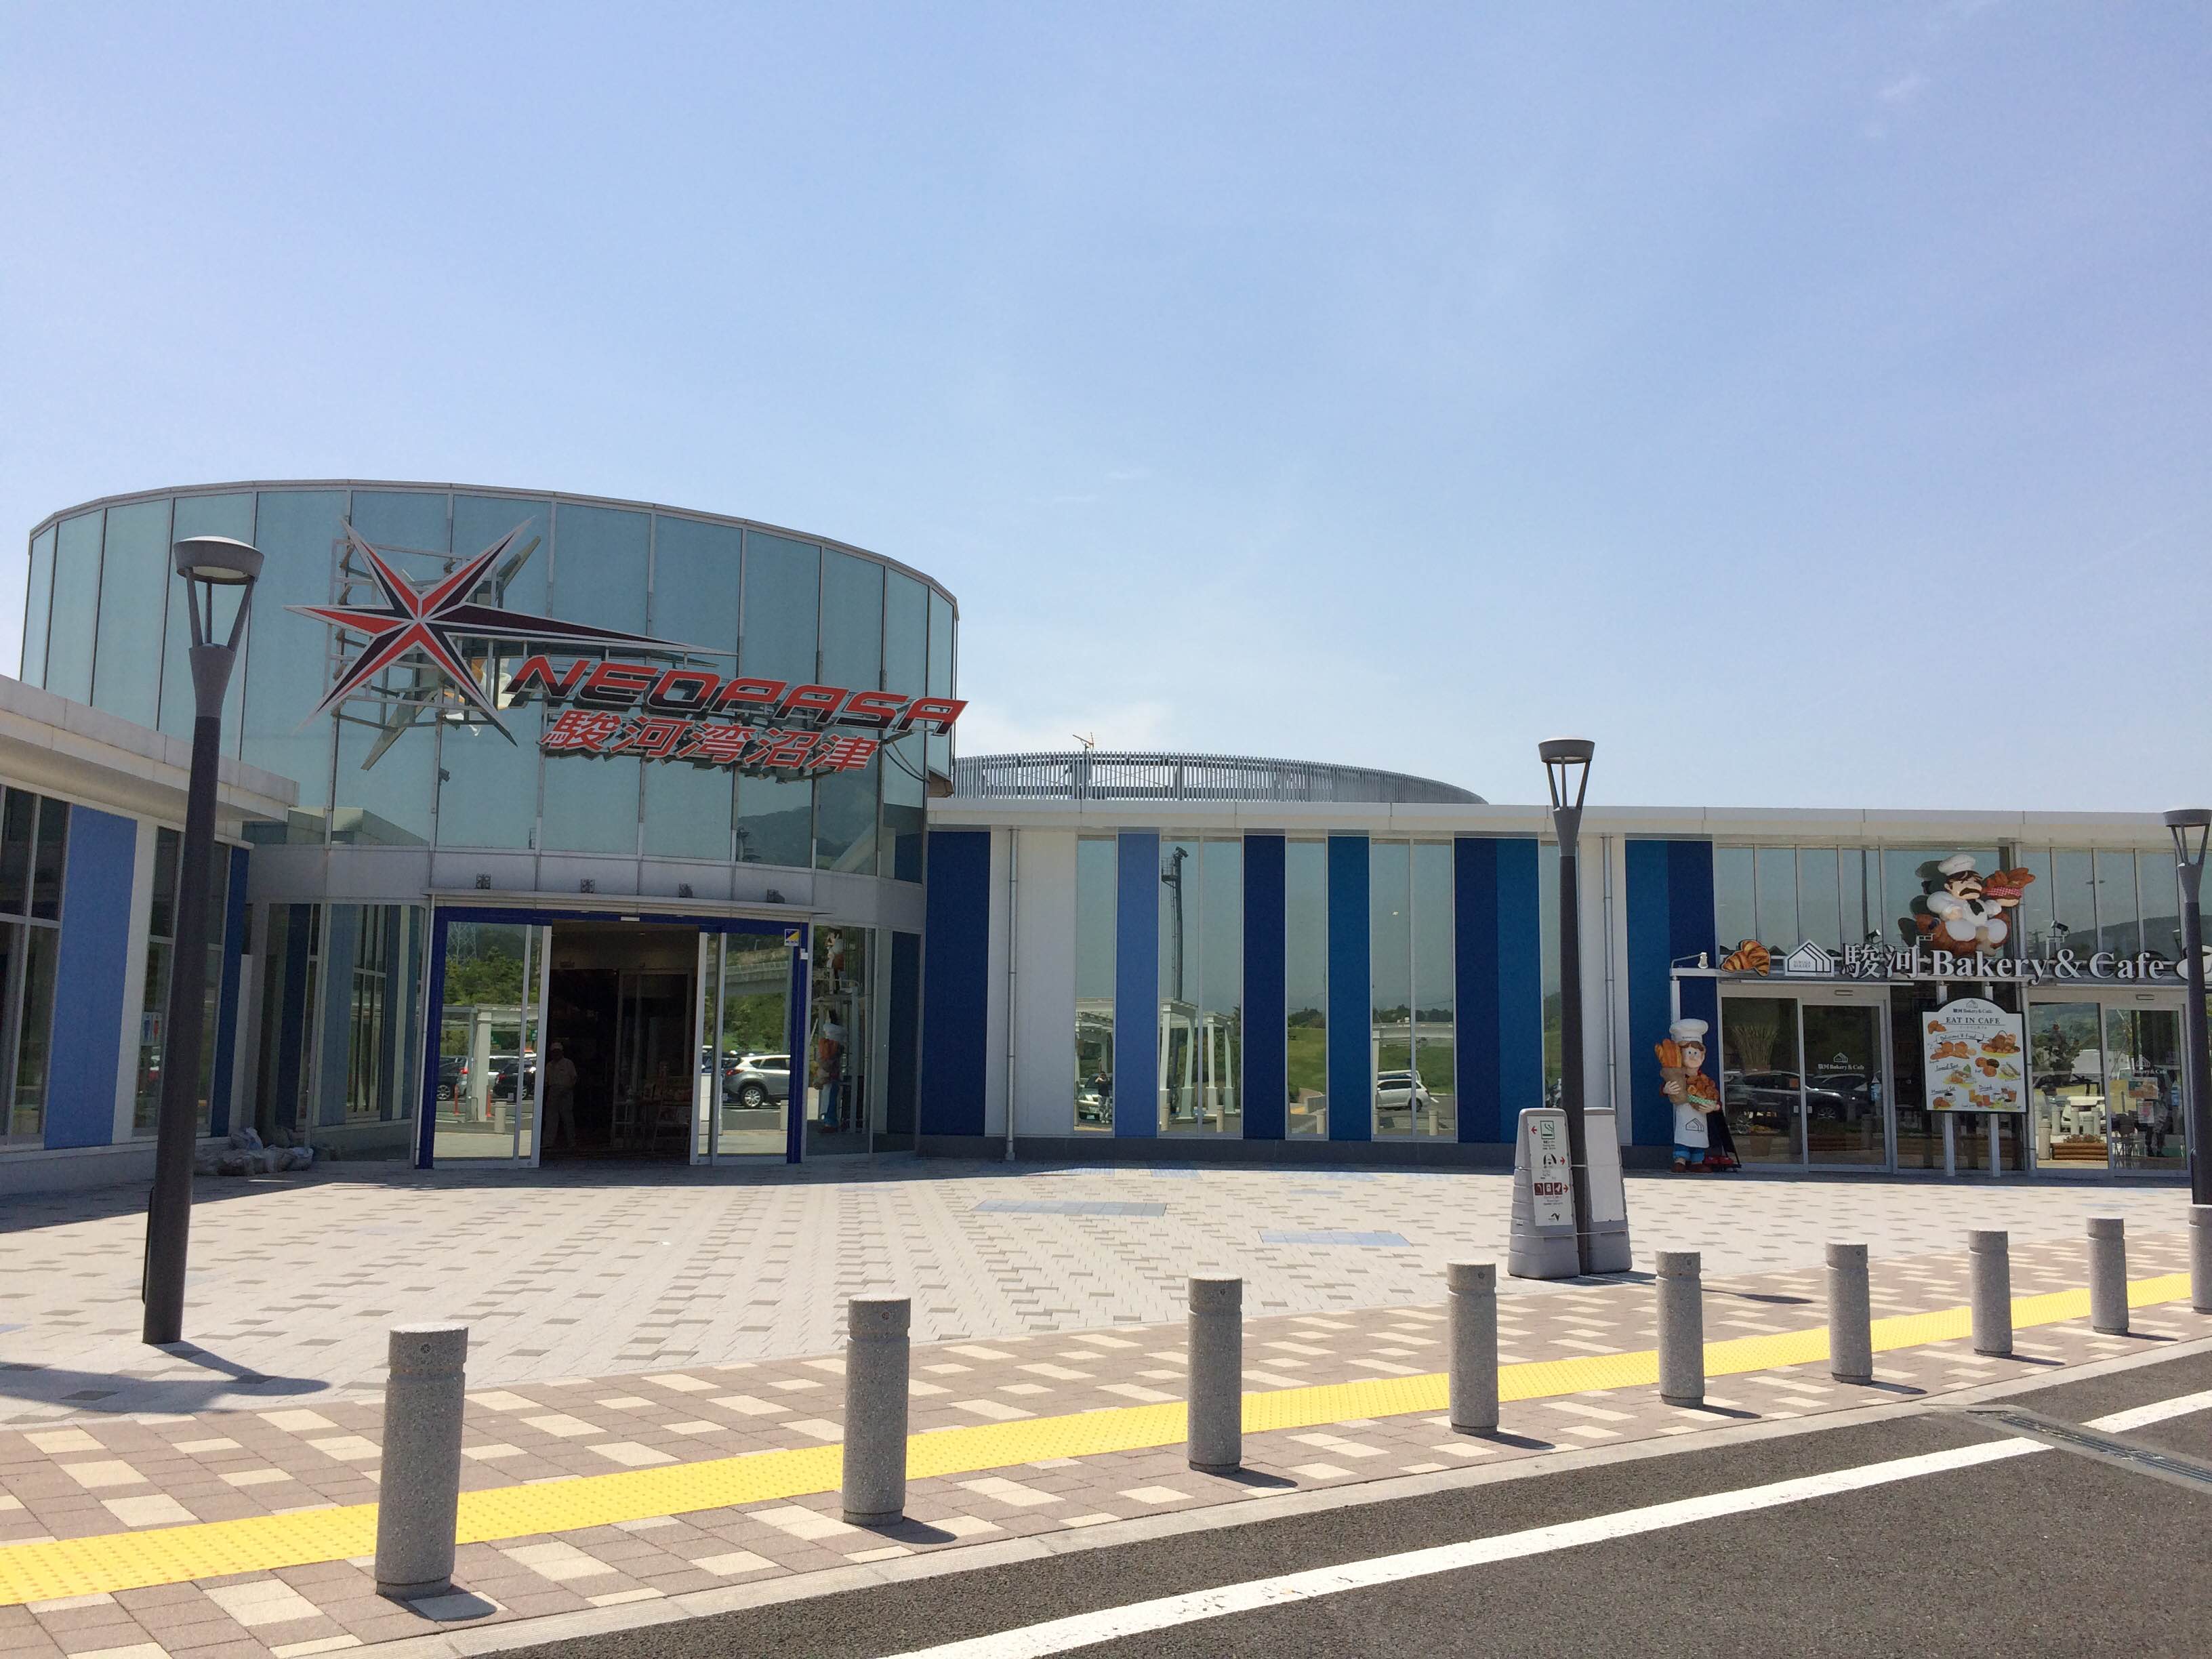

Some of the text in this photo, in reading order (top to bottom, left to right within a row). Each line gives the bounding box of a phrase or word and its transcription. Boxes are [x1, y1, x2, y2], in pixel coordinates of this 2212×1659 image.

[501, 655, 969, 737] NEOPASA
[541, 709, 880, 773] 駿河湾沼津
[1841, 943, 2165, 985] 駿河 Bakery & Cafe
